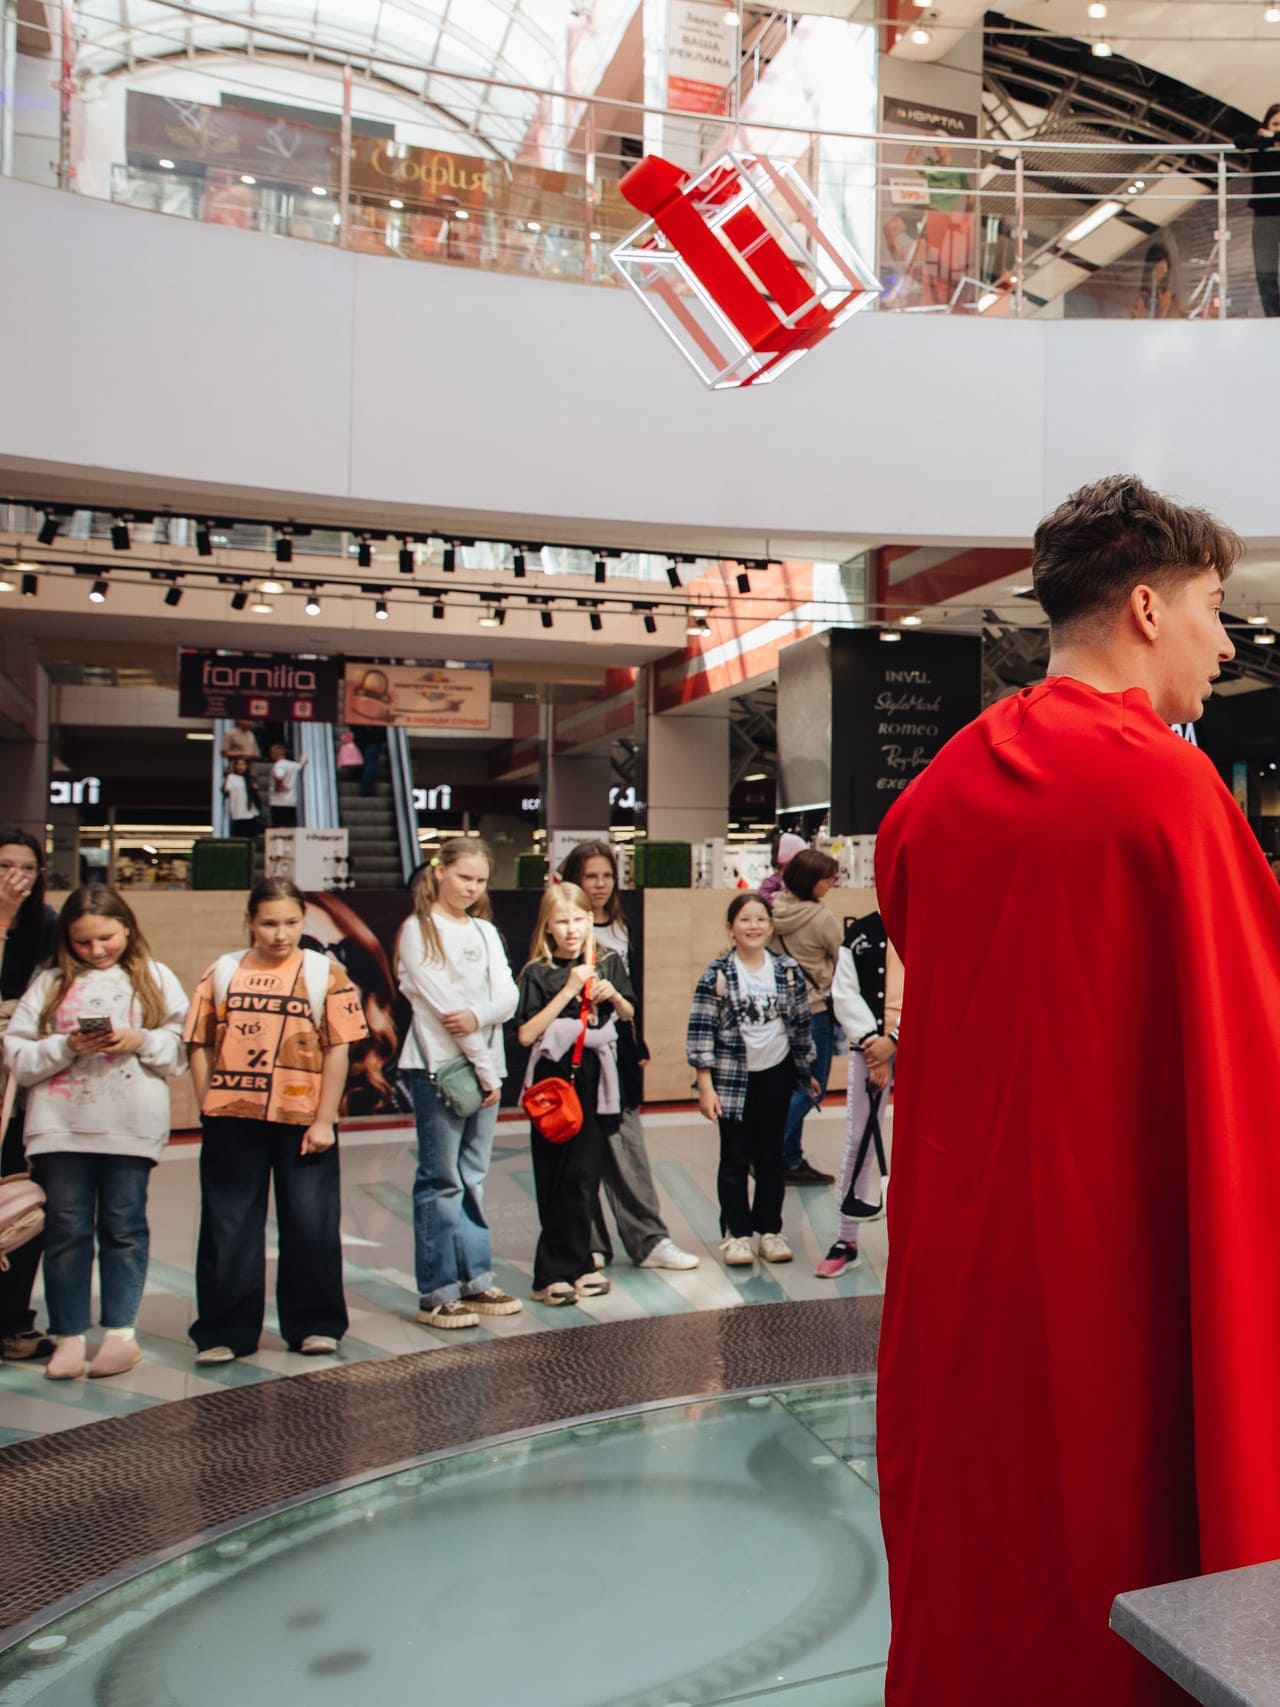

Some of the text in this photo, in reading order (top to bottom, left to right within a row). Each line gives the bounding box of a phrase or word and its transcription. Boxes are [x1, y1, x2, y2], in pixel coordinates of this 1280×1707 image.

[370, 139, 491, 195] София
[203, 660, 316, 690] familia
[228, 996, 281, 1011] GIVE
[235, 1021, 262, 1036] YES
[211, 1074, 268, 1089] OVER
